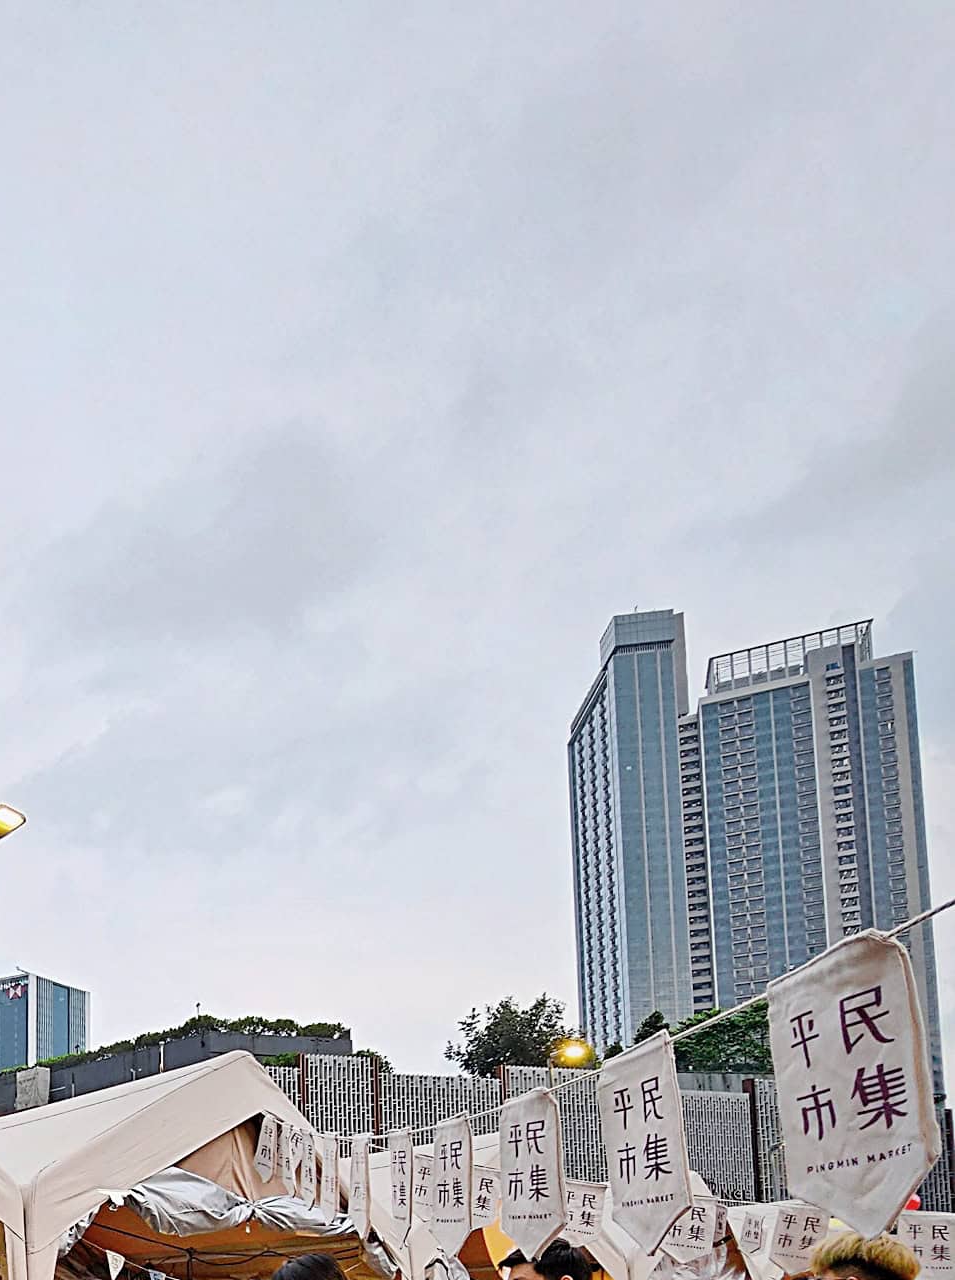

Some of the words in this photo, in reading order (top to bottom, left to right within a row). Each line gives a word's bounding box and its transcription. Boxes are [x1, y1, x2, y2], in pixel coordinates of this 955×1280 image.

[790, 985, 895, 1069] 平民
[613, 1076, 664, 1131] 平民
[796, 1063, 908, 1141] 市集
[438, 1140, 463, 1172] 平民
[507, 1119, 546, 1159] 平民
[617, 1133, 672, 1185] 市集
[806, 1156, 859, 1175] PINGMIN
[866, 1143, 913, 1165] MARKET
[437, 1177, 464, 1209] 市集
[507, 1163, 550, 1203] 市集
[782, 1213, 821, 1234] 平民
[906, 1223, 950, 1242] 平民
